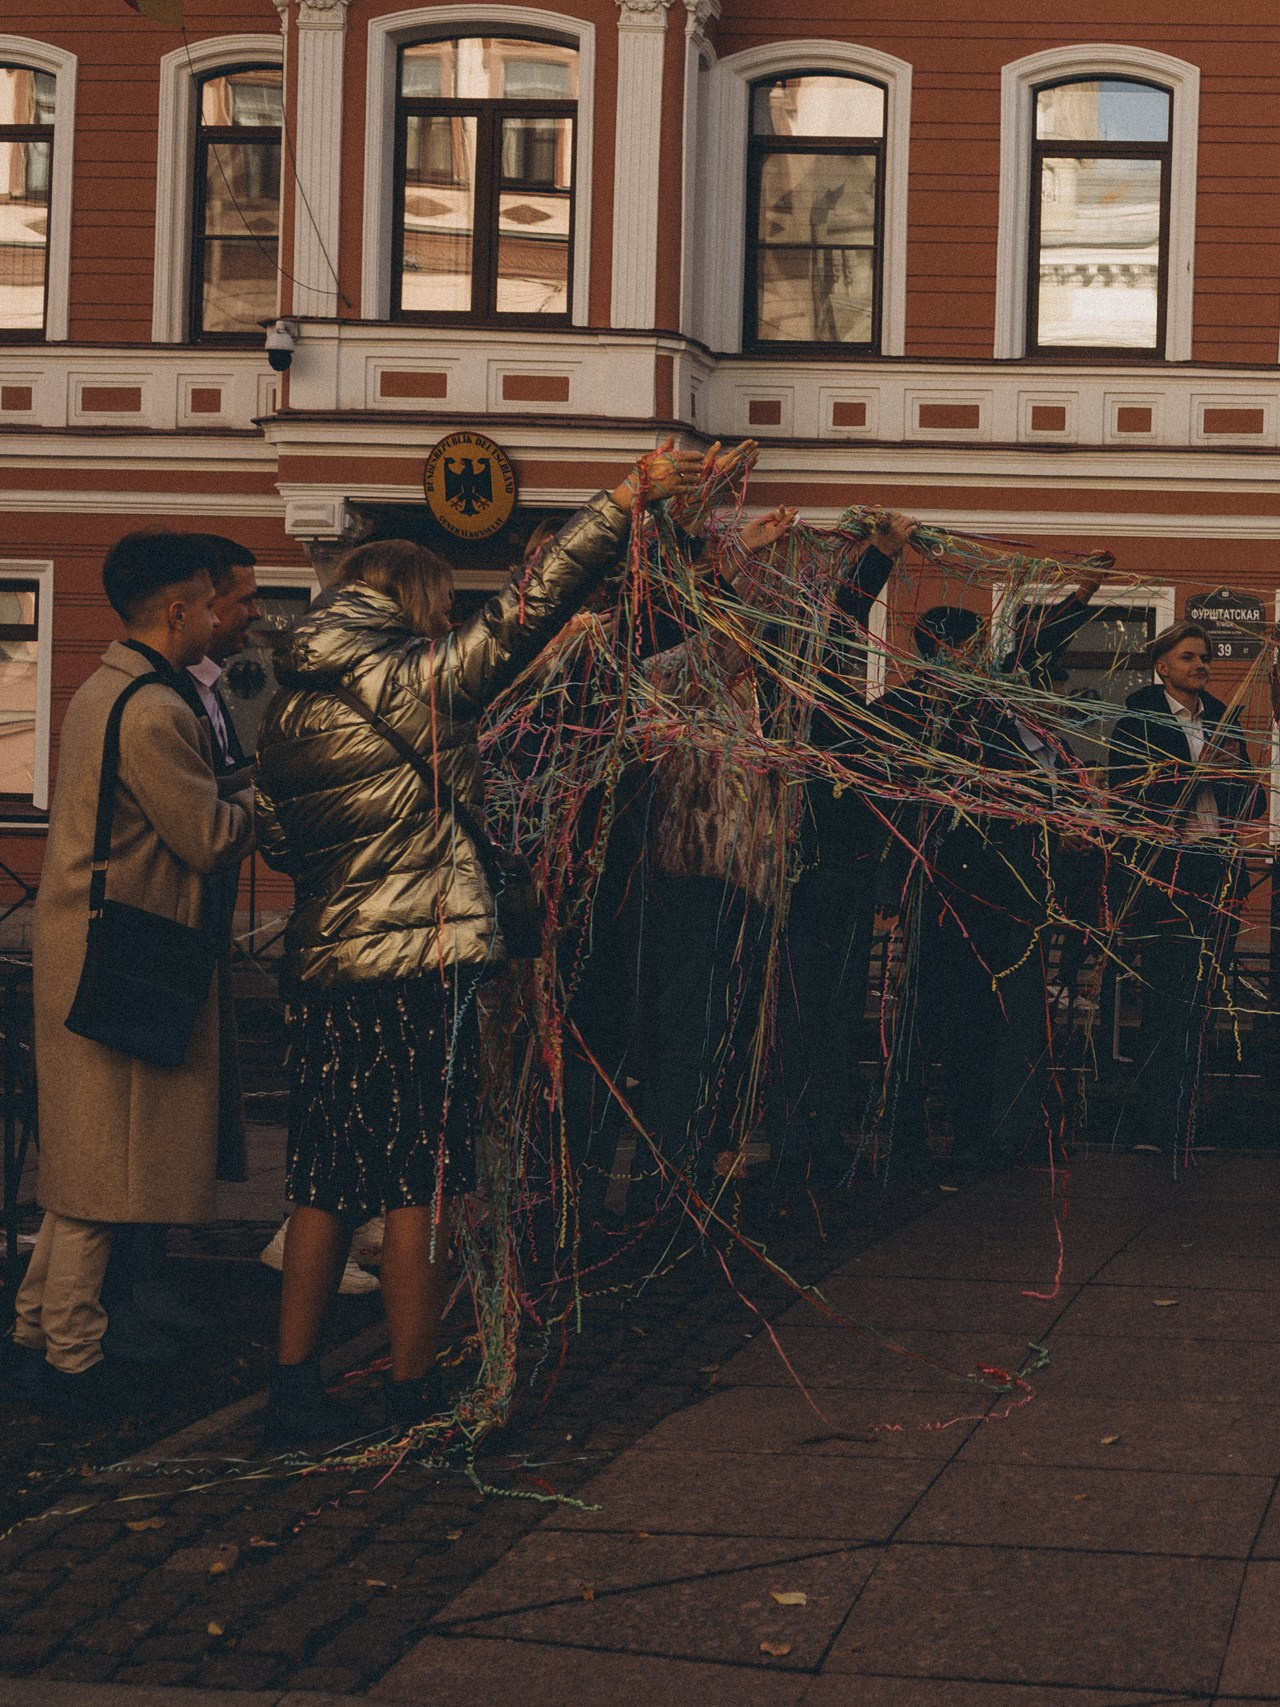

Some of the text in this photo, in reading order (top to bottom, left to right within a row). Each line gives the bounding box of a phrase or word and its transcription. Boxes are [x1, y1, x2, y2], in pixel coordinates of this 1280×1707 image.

[427, 434, 513, 493] BUNDESREPUBLIK DEUTSCHLAND
[1191, 609, 1260, 620] ФУРШТАТСКАЯ
[1217, 644, 1232, 657] 39
